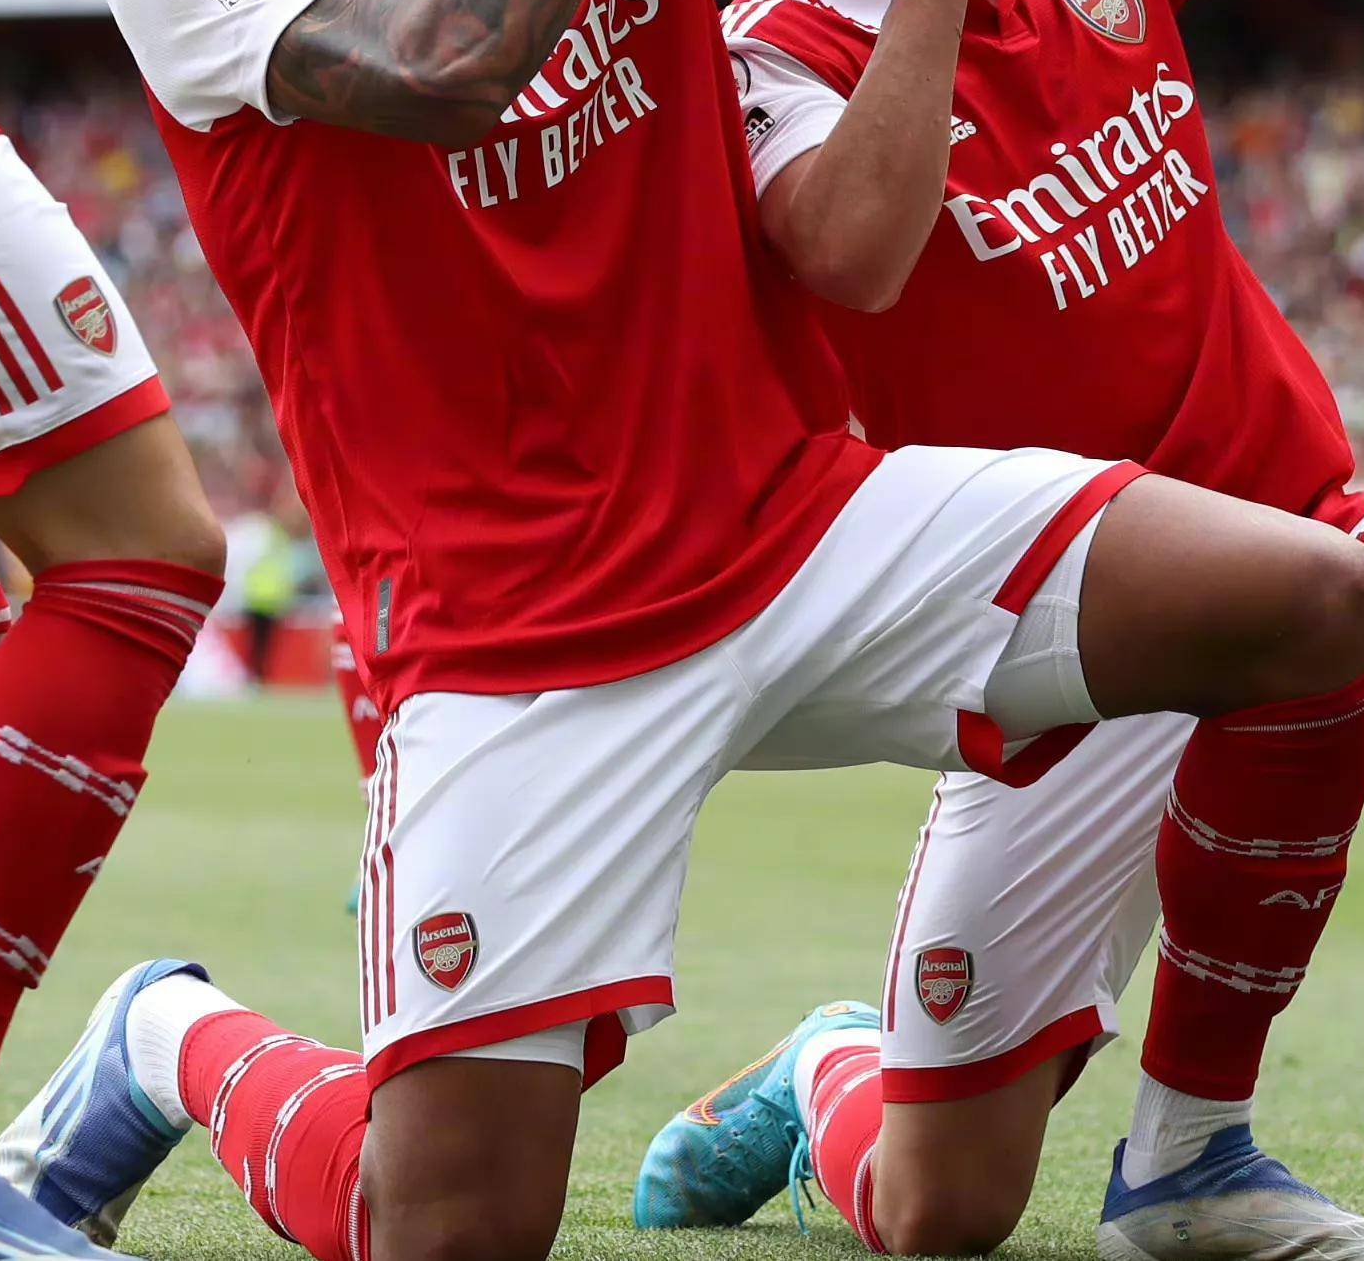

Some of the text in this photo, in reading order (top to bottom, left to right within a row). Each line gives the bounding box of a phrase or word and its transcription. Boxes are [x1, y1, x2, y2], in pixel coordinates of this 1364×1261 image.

[447, 56, 658, 210] FLY BETTER
[943, 61, 1194, 262] Emirates
[1039, 225, 1109, 311] FLY
[419, 921, 469, 944] Arsenal
[921, 959, 966, 973] Arsenal
